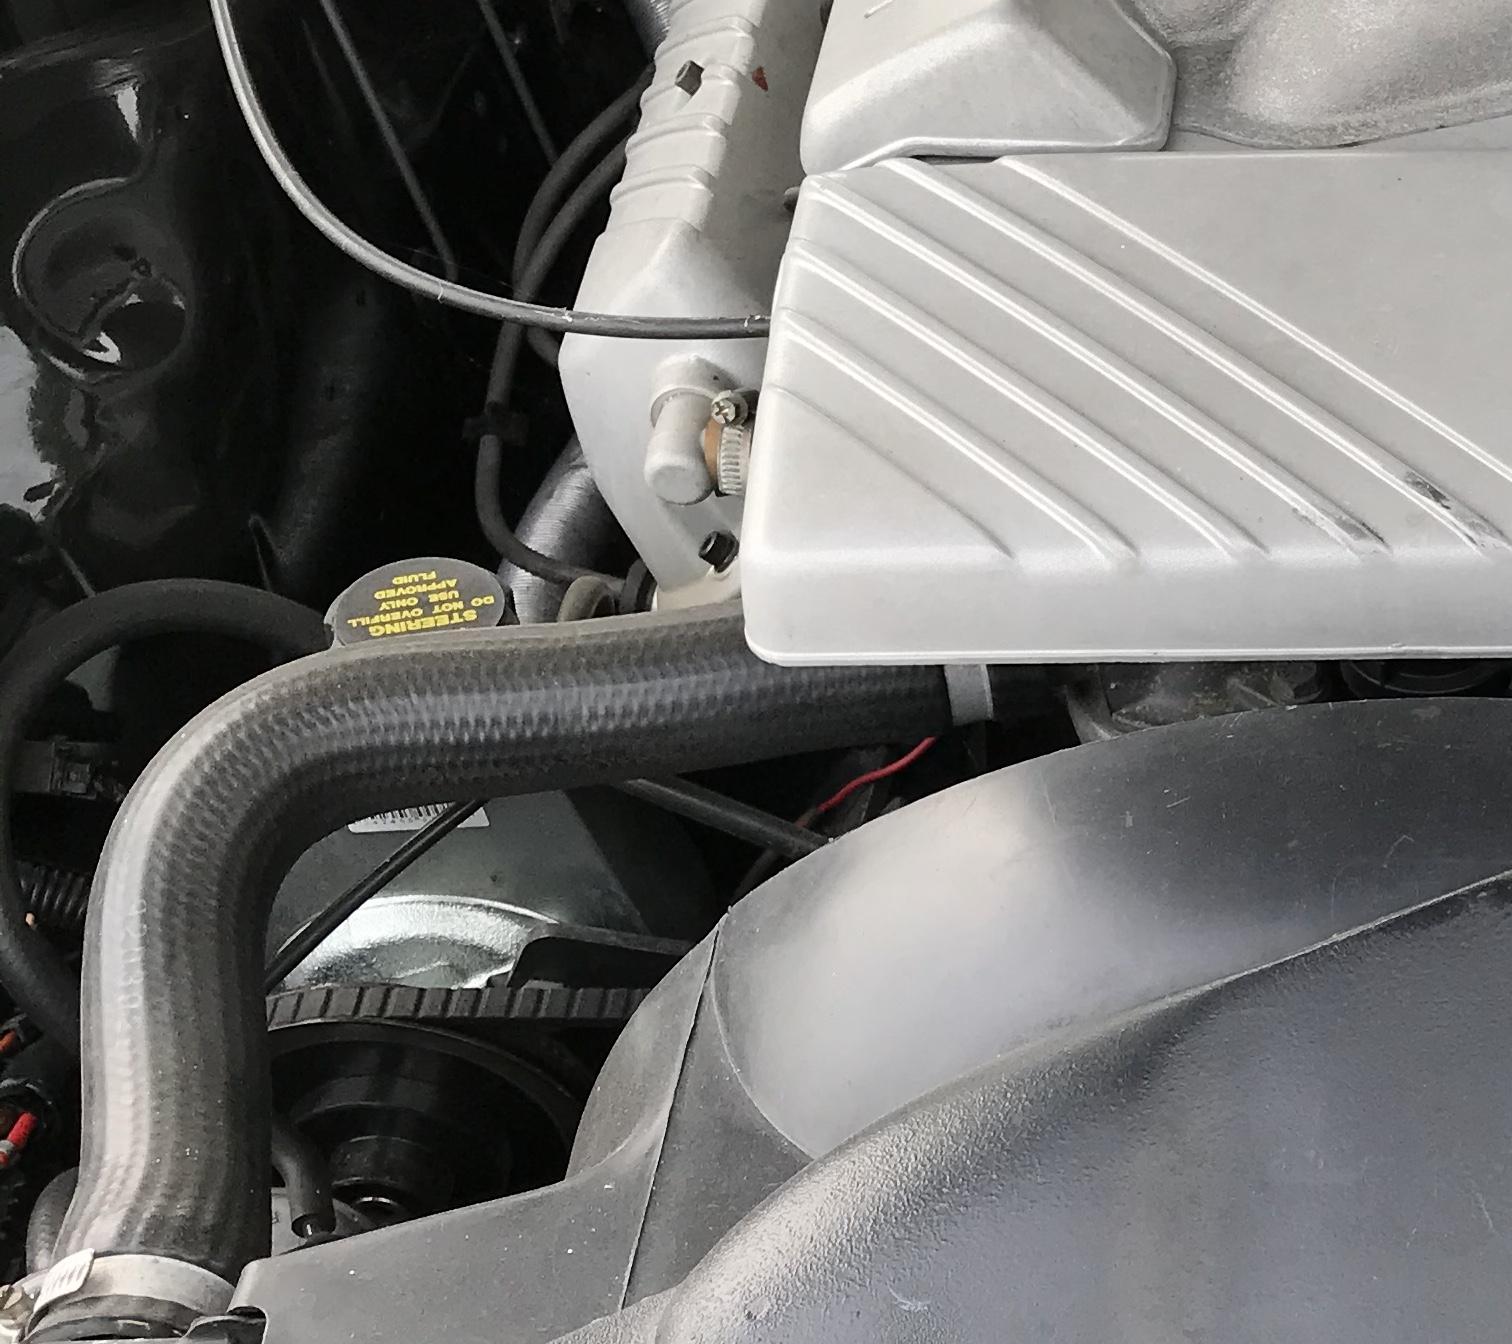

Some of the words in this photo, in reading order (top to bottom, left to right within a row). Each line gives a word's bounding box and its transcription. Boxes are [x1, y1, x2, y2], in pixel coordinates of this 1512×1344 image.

[392, 570, 437, 585] FLUID
[374, 578, 458, 600] APPROVED
[428, 590, 459, 603] USE
[471, 595, 495, 607] DO
[379, 597, 419, 611] ONLY
[432, 600, 464, 614] NOT
[347, 607, 423, 627] OVERFILL
[369, 609, 477, 637] STEERING
